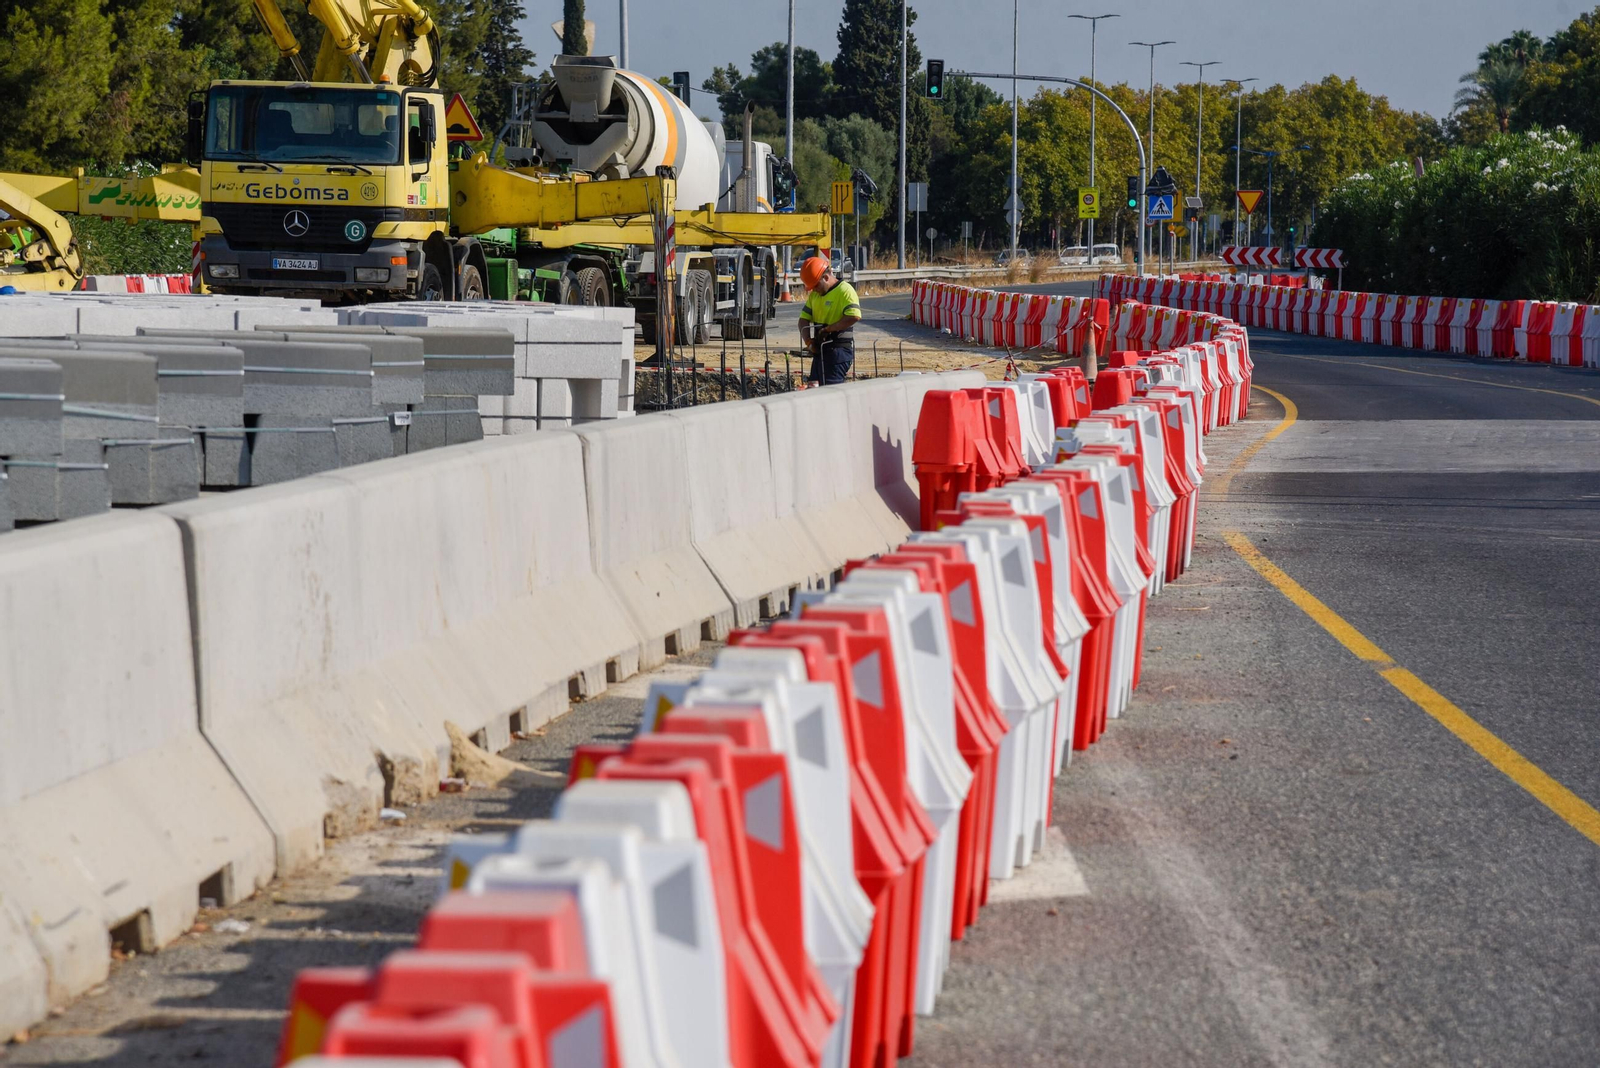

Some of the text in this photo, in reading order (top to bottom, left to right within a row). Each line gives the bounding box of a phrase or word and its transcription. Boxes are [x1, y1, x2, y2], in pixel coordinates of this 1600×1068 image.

[88, 180, 201, 210] PENINSU
[246, 183, 348, 200] Gebomsa
[351, 224, 360, 237] G
[288, 260, 307, 269] 3424
[307, 260, 318, 270] AJ
